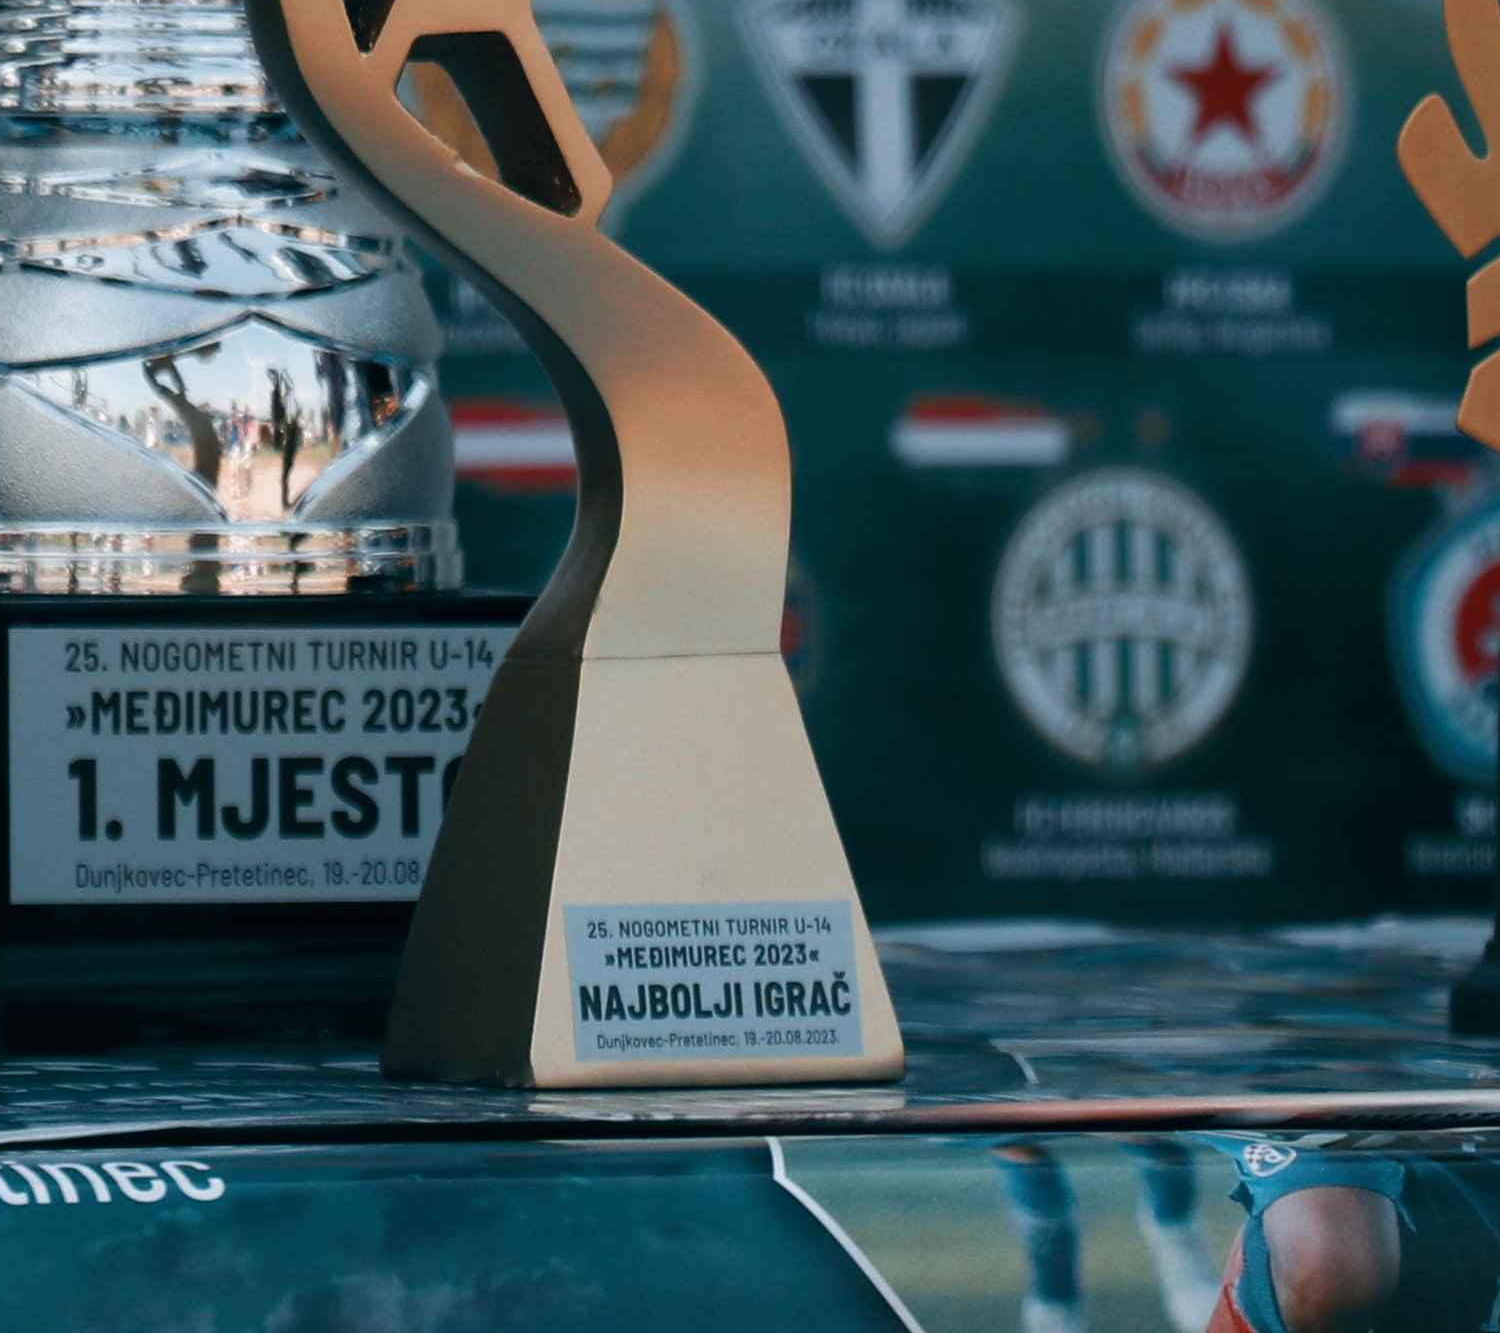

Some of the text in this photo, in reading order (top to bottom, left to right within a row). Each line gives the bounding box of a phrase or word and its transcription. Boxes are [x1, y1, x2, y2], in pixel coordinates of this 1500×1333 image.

[65, 639, 495, 673] 25. NOGOMETNI TURNIR U-14
[66, 689, 346, 734] »MEĐIMUREC
[68, 754, 464, 841] 1. MJEST
[75, 861, 314, 894] Dunjkovec-Pretetinec,
[587, 916, 832, 939] 25. NOGOMETNI TURNIR U-14
[605, 943, 820, 970] »MEĐIMUREC 2023«
[579, 971, 851, 1022] NAJBOLJI IGRAČ
